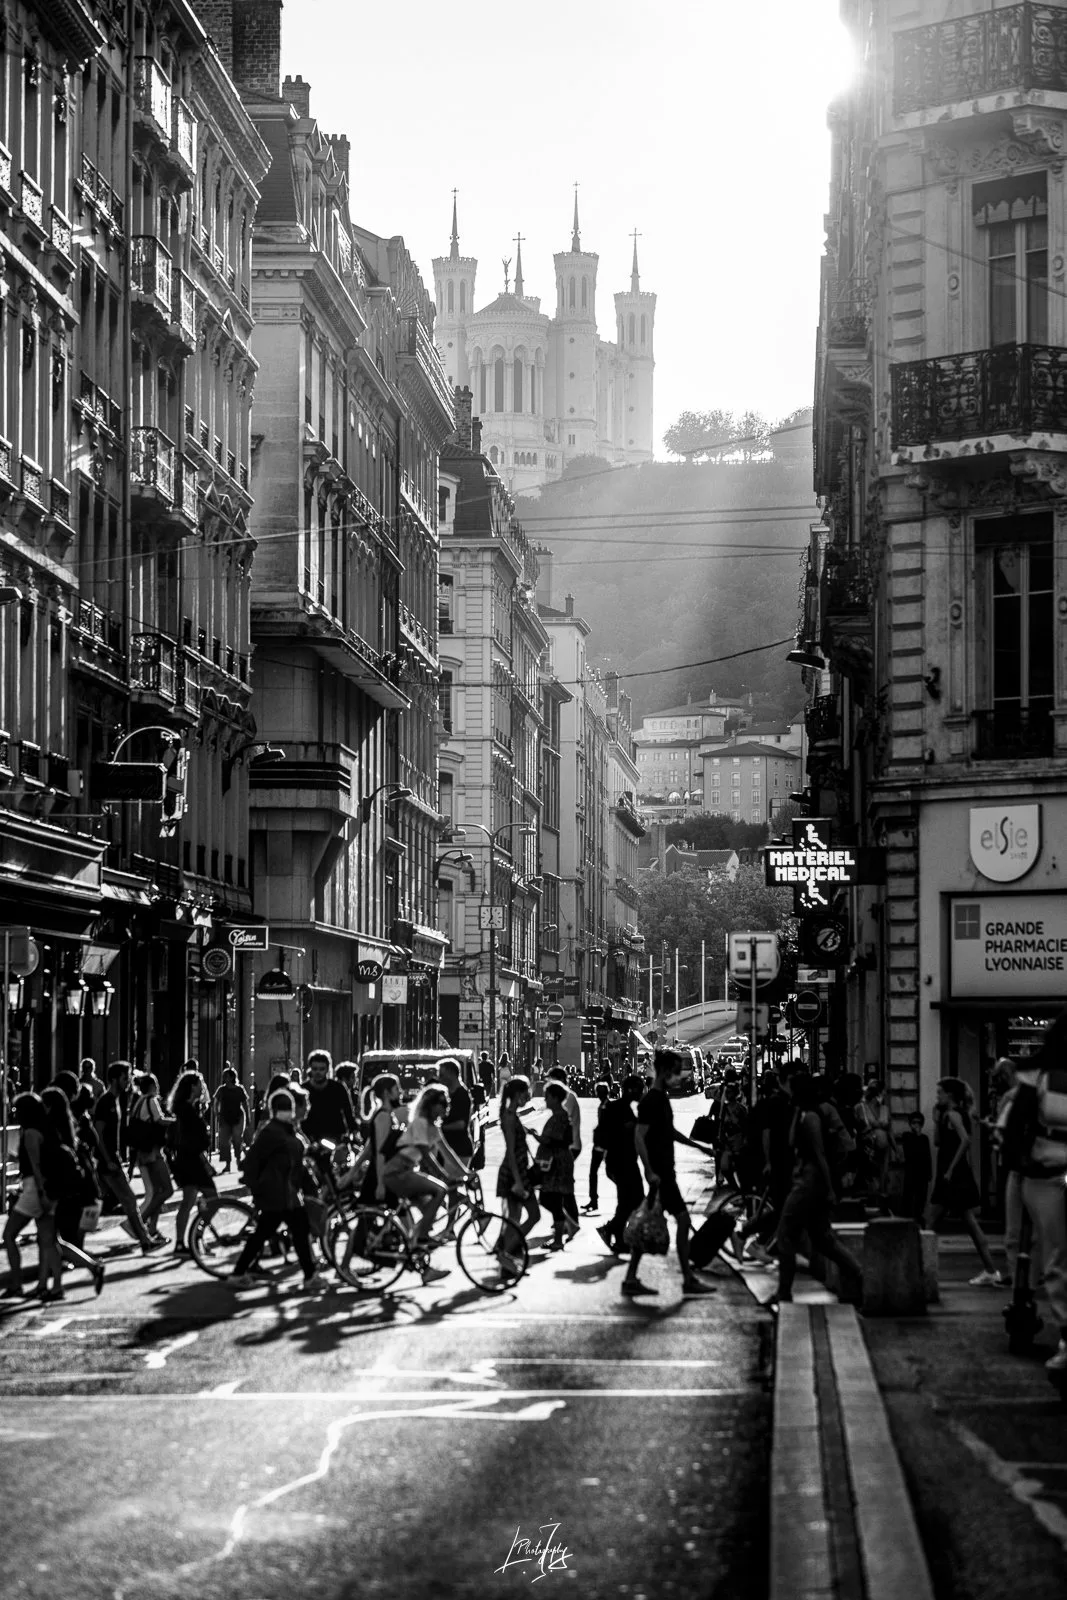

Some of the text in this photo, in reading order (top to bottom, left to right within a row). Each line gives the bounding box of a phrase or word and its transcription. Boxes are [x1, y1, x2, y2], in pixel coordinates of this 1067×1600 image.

[775, 866, 851, 881] MEDICAL
[985, 921, 1044, 936] GRANDE
[985, 938, 1067, 954] PHARMACIE
[985, 956, 1064, 972] LYONNAISE
